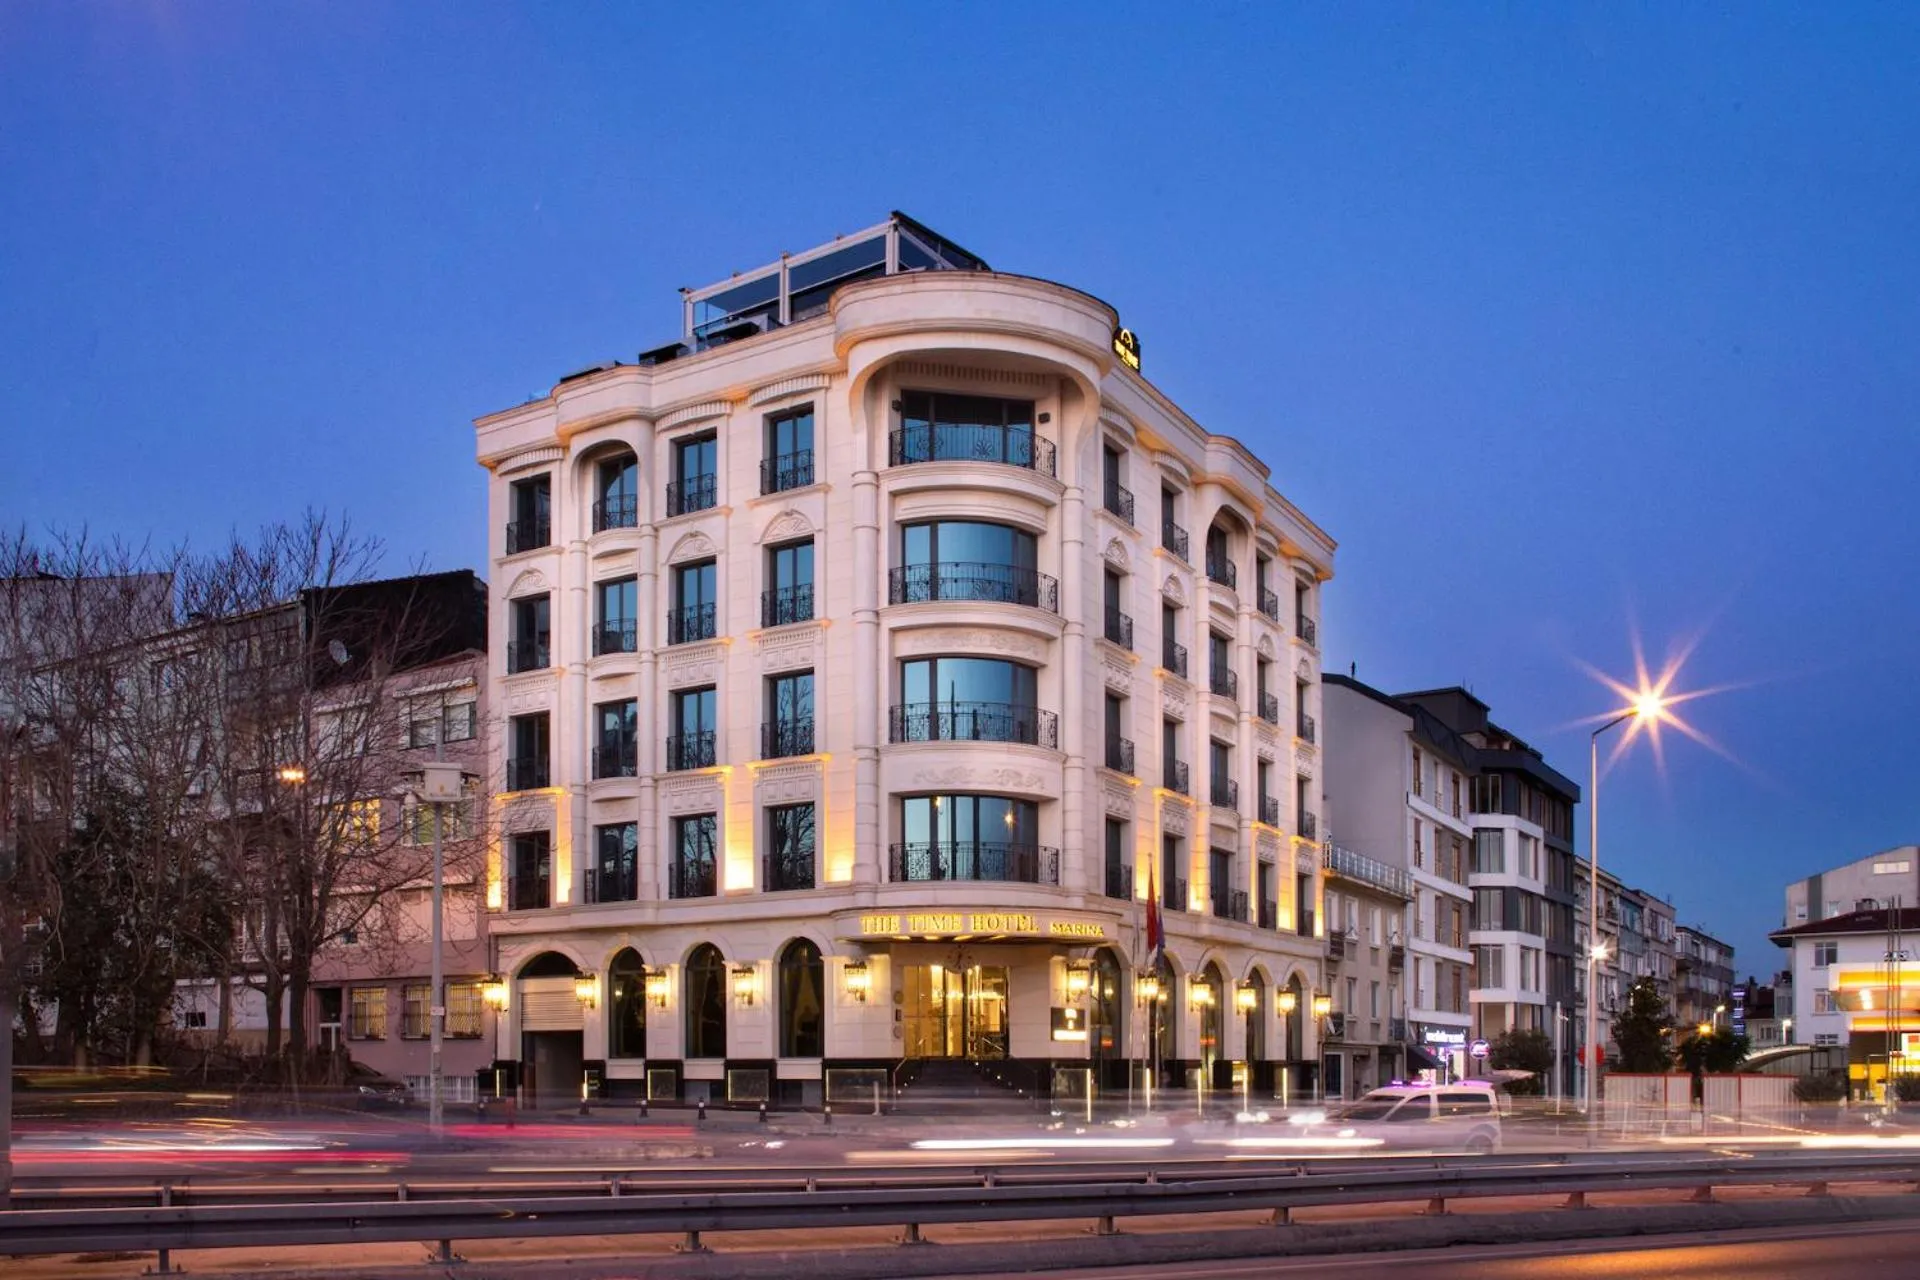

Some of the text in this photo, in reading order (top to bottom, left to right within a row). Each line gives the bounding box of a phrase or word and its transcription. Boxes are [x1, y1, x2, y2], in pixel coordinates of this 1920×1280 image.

[861, 913, 1105, 937] THE TIME HOTEL MARINA
